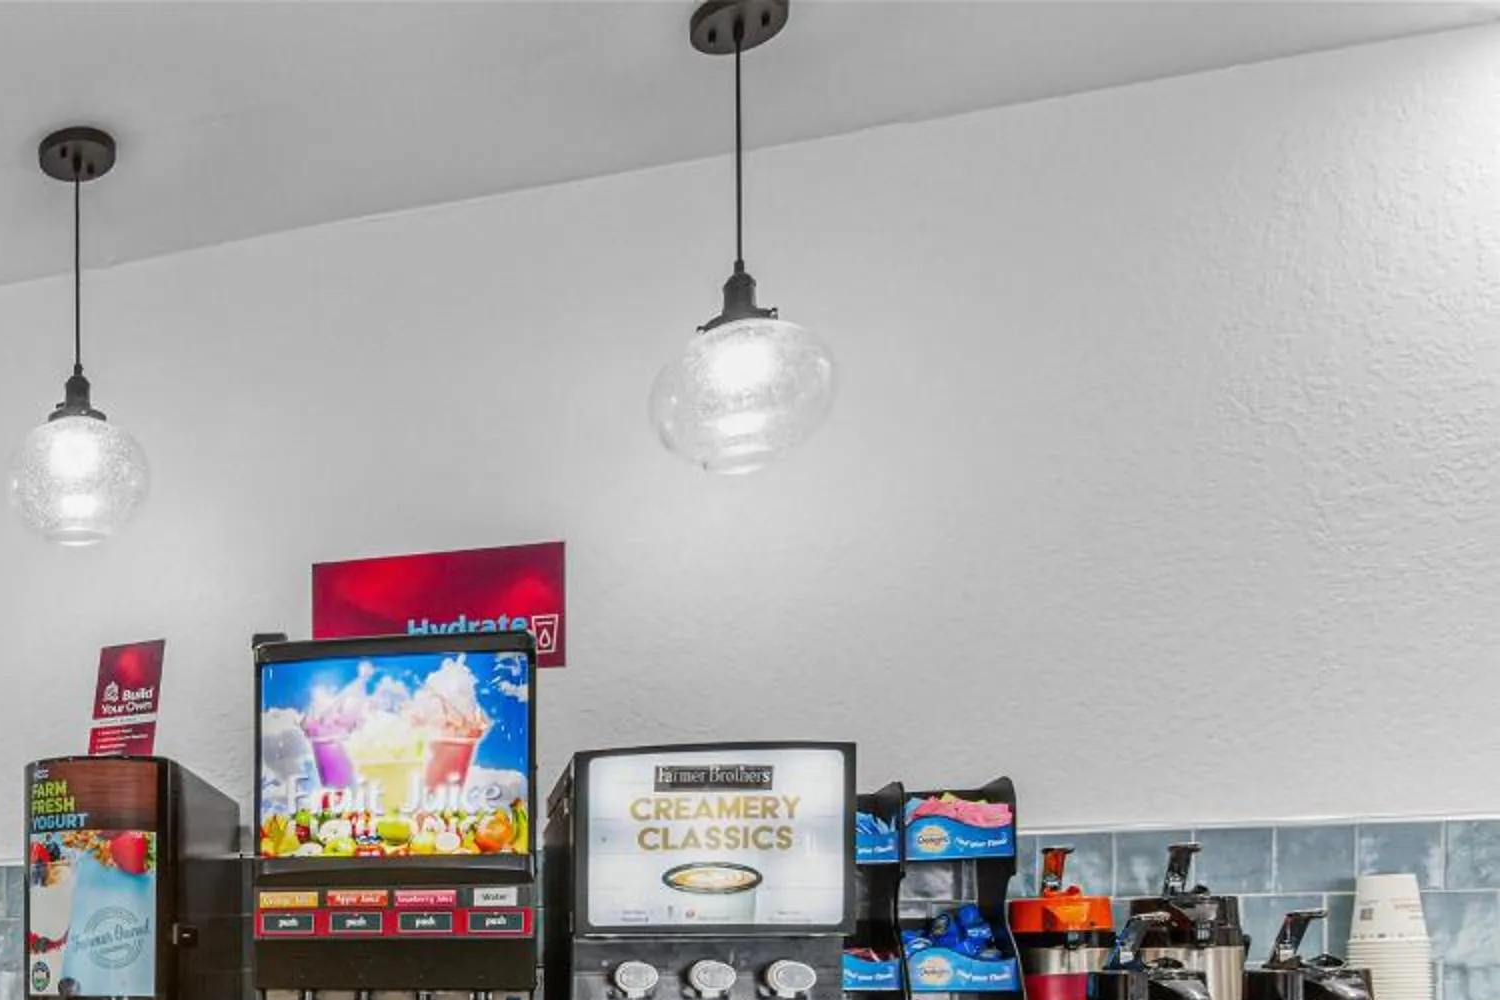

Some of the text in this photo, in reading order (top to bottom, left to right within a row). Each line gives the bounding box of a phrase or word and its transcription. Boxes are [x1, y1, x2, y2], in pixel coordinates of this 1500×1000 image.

[407, 613, 528, 636] Hydrate
[122, 686, 154, 702] Build
[657, 764, 772, 784] Farmer Brothers
[31, 781, 67, 798] FARM
[31, 797, 75, 814] FRESH
[629, 795, 800, 821] CREAMERY
[33, 813, 88, 830] YOGURT
[637, 824, 794, 850] CLASSICS
